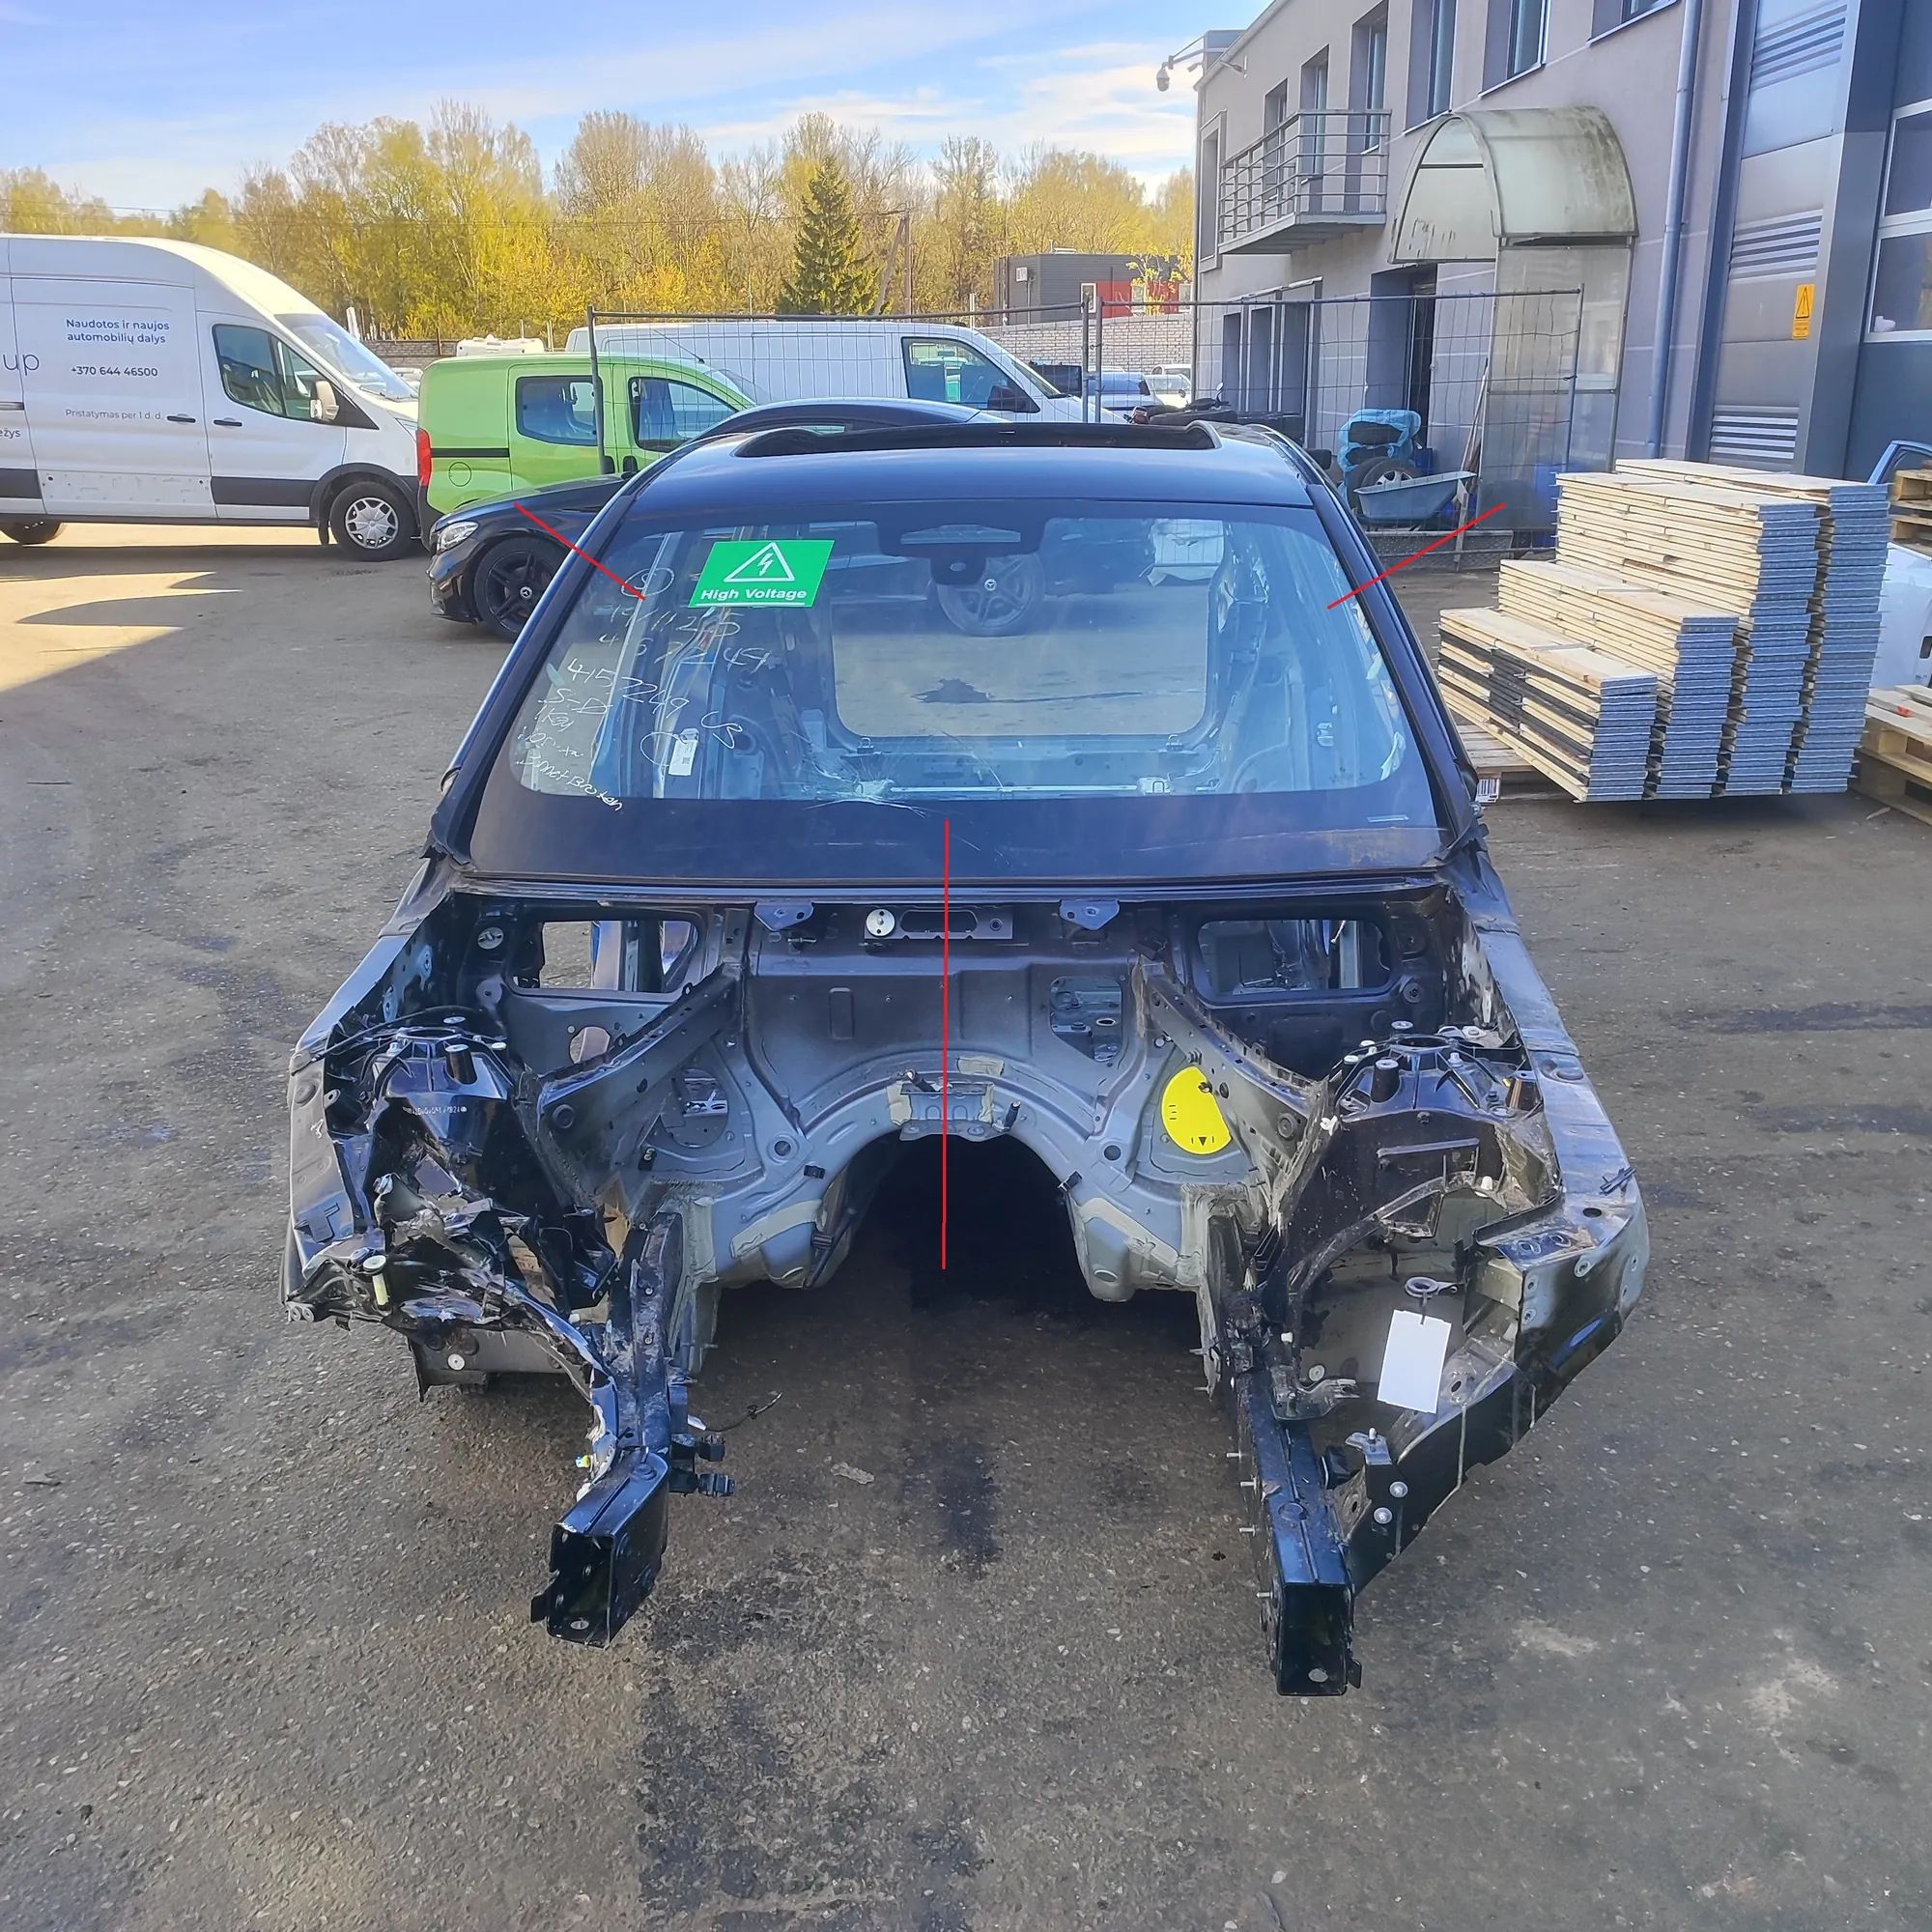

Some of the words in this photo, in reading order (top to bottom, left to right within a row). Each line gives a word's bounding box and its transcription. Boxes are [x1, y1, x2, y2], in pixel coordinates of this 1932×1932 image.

[66, 319, 120, 330] Naudotos
[122, 320, 130, 330] ir
[132, 320, 170, 332] naujos
[67, 332, 134, 345] automobilių
[136, 333, 166, 346] dalys
[3, 354, 40, 377] up
[71, 366, 97, 377] +370
[99, 366, 121, 377] 644
[124, 367, 158, 378] 46500
[65, 409, 120, 420] Pristatymas
[121, 412, 136, 421] per
[700, 588, 740, 602] High
[745, 587, 808, 602] Voltage
